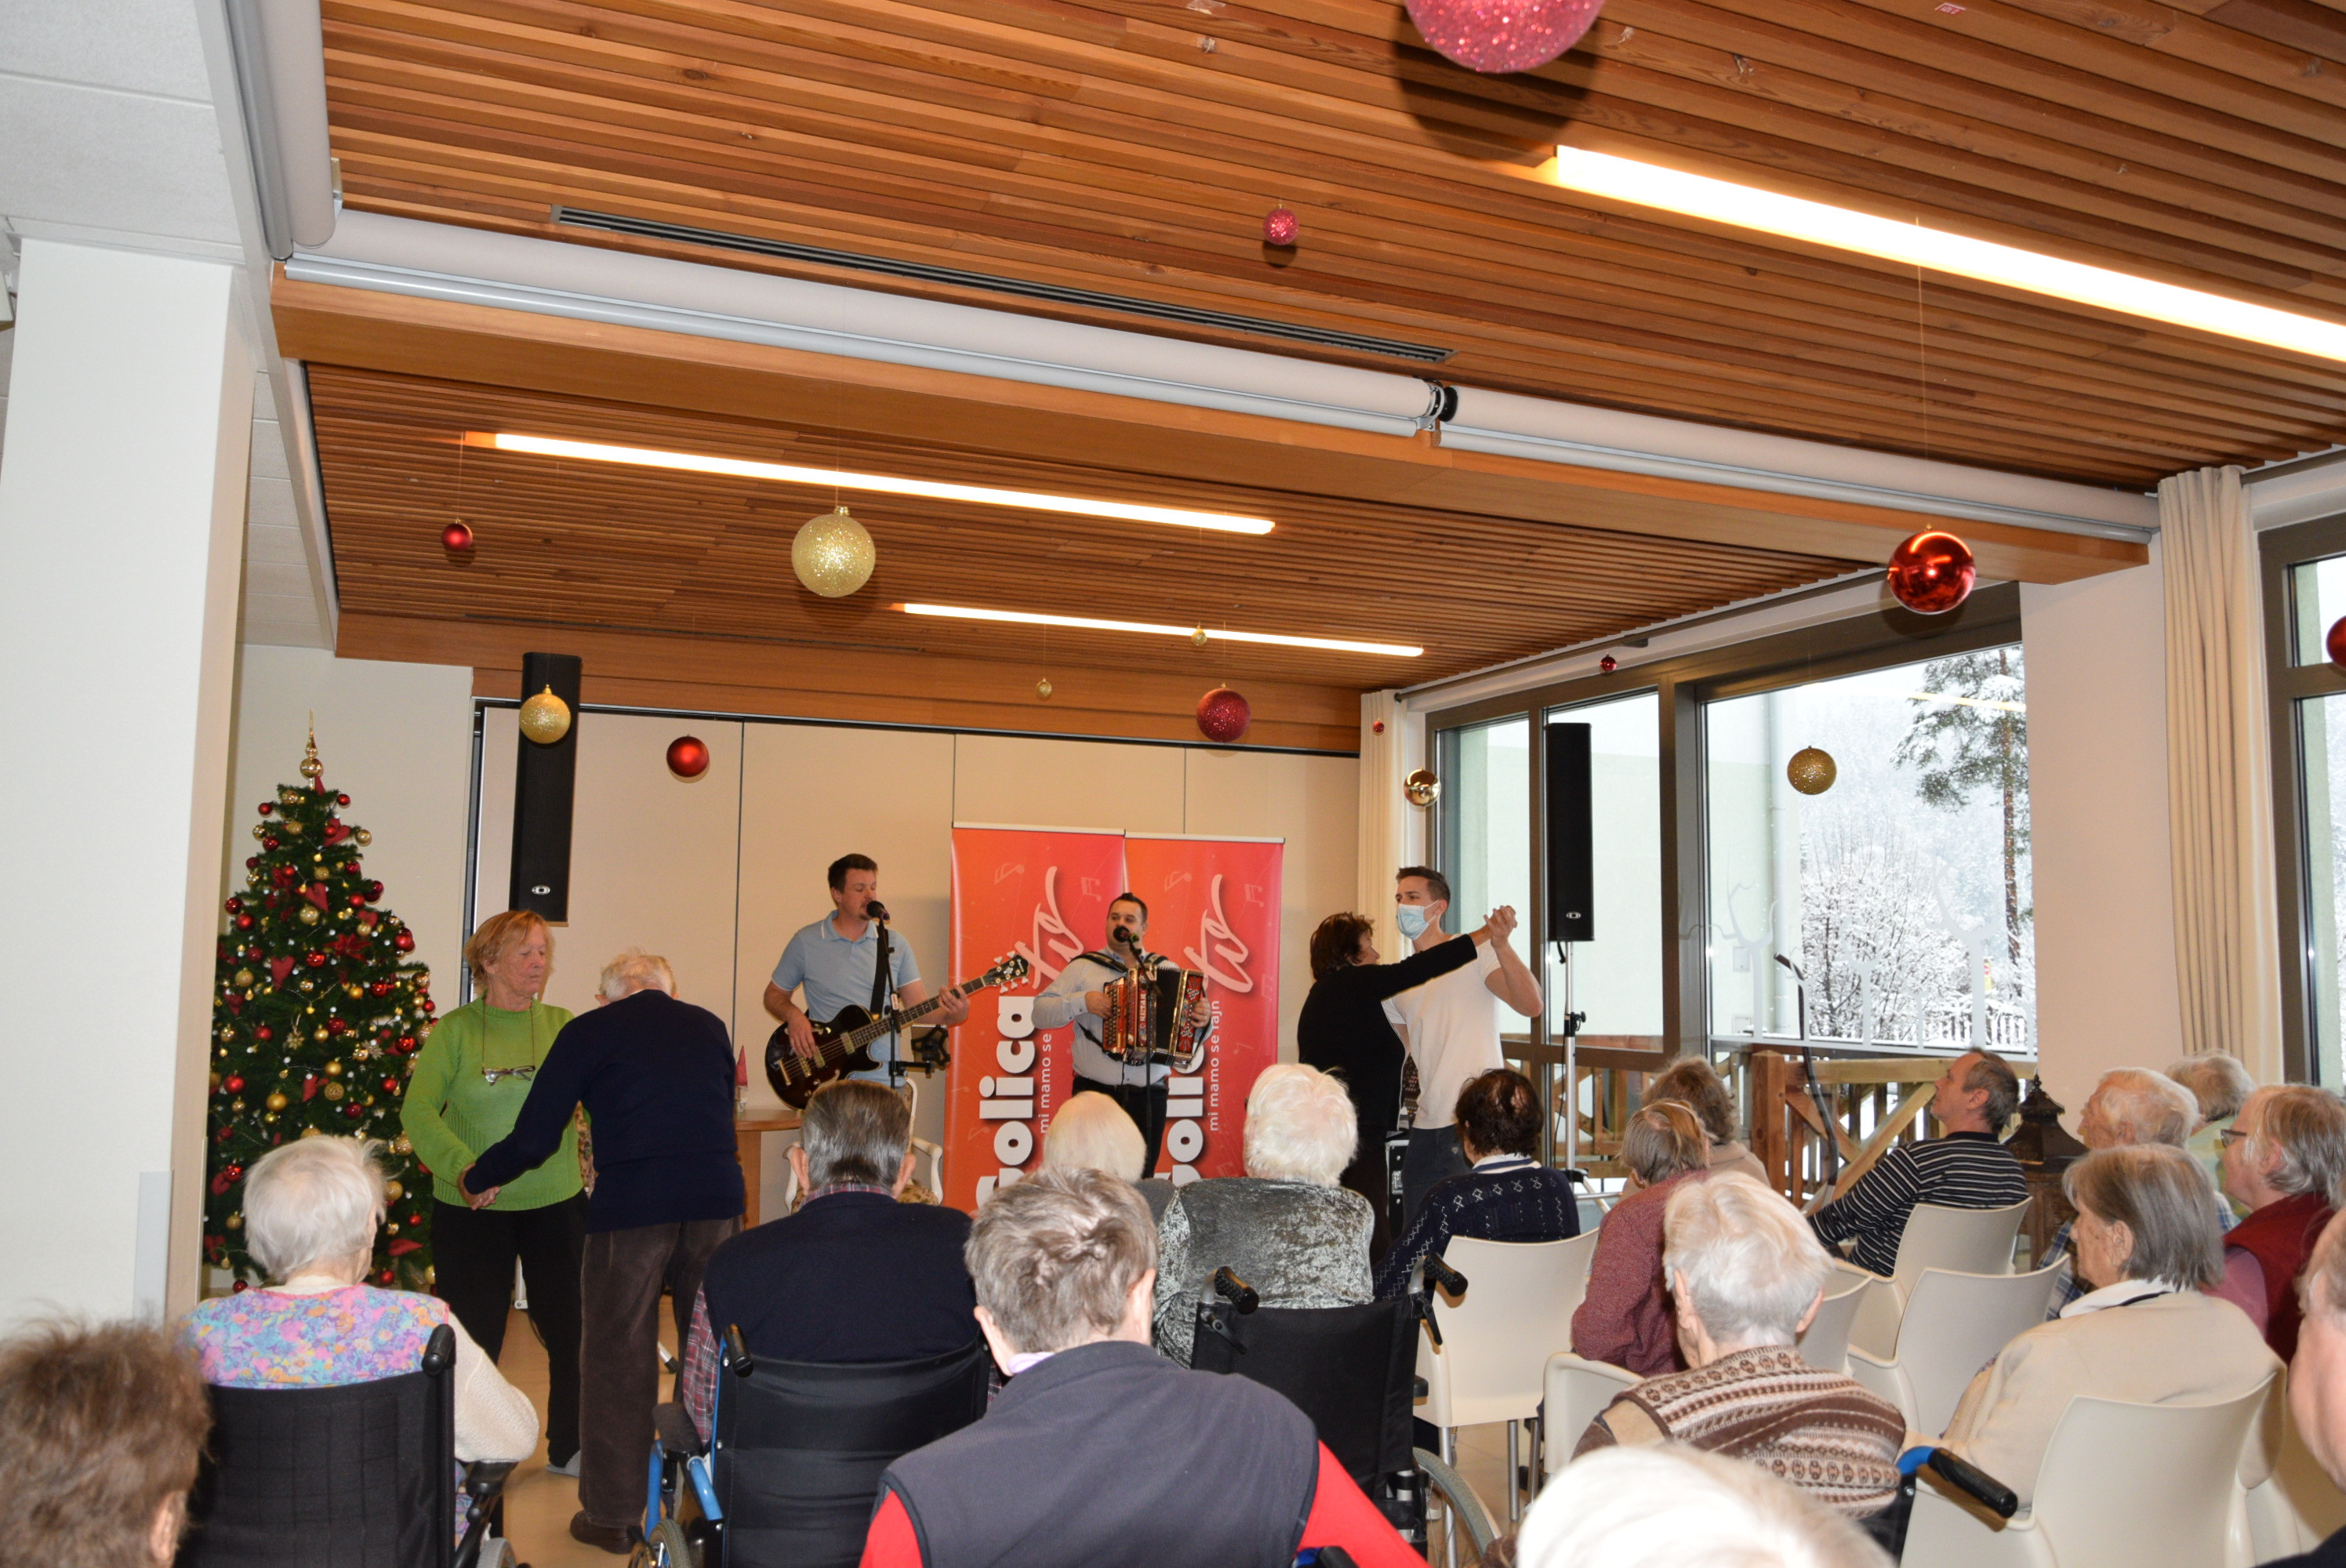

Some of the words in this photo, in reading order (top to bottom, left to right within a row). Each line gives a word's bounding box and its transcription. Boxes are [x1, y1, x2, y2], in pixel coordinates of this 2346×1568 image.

[1042, 1033, 1051, 1052] se
[1211, 1035, 1219, 1052] se
[1040, 1057, 1051, 1109] mamo
[1210, 1058, 1219, 1107] mamo
[1038, 1114, 1050, 1134] mi
[1208, 1112, 1219, 1131] mi
